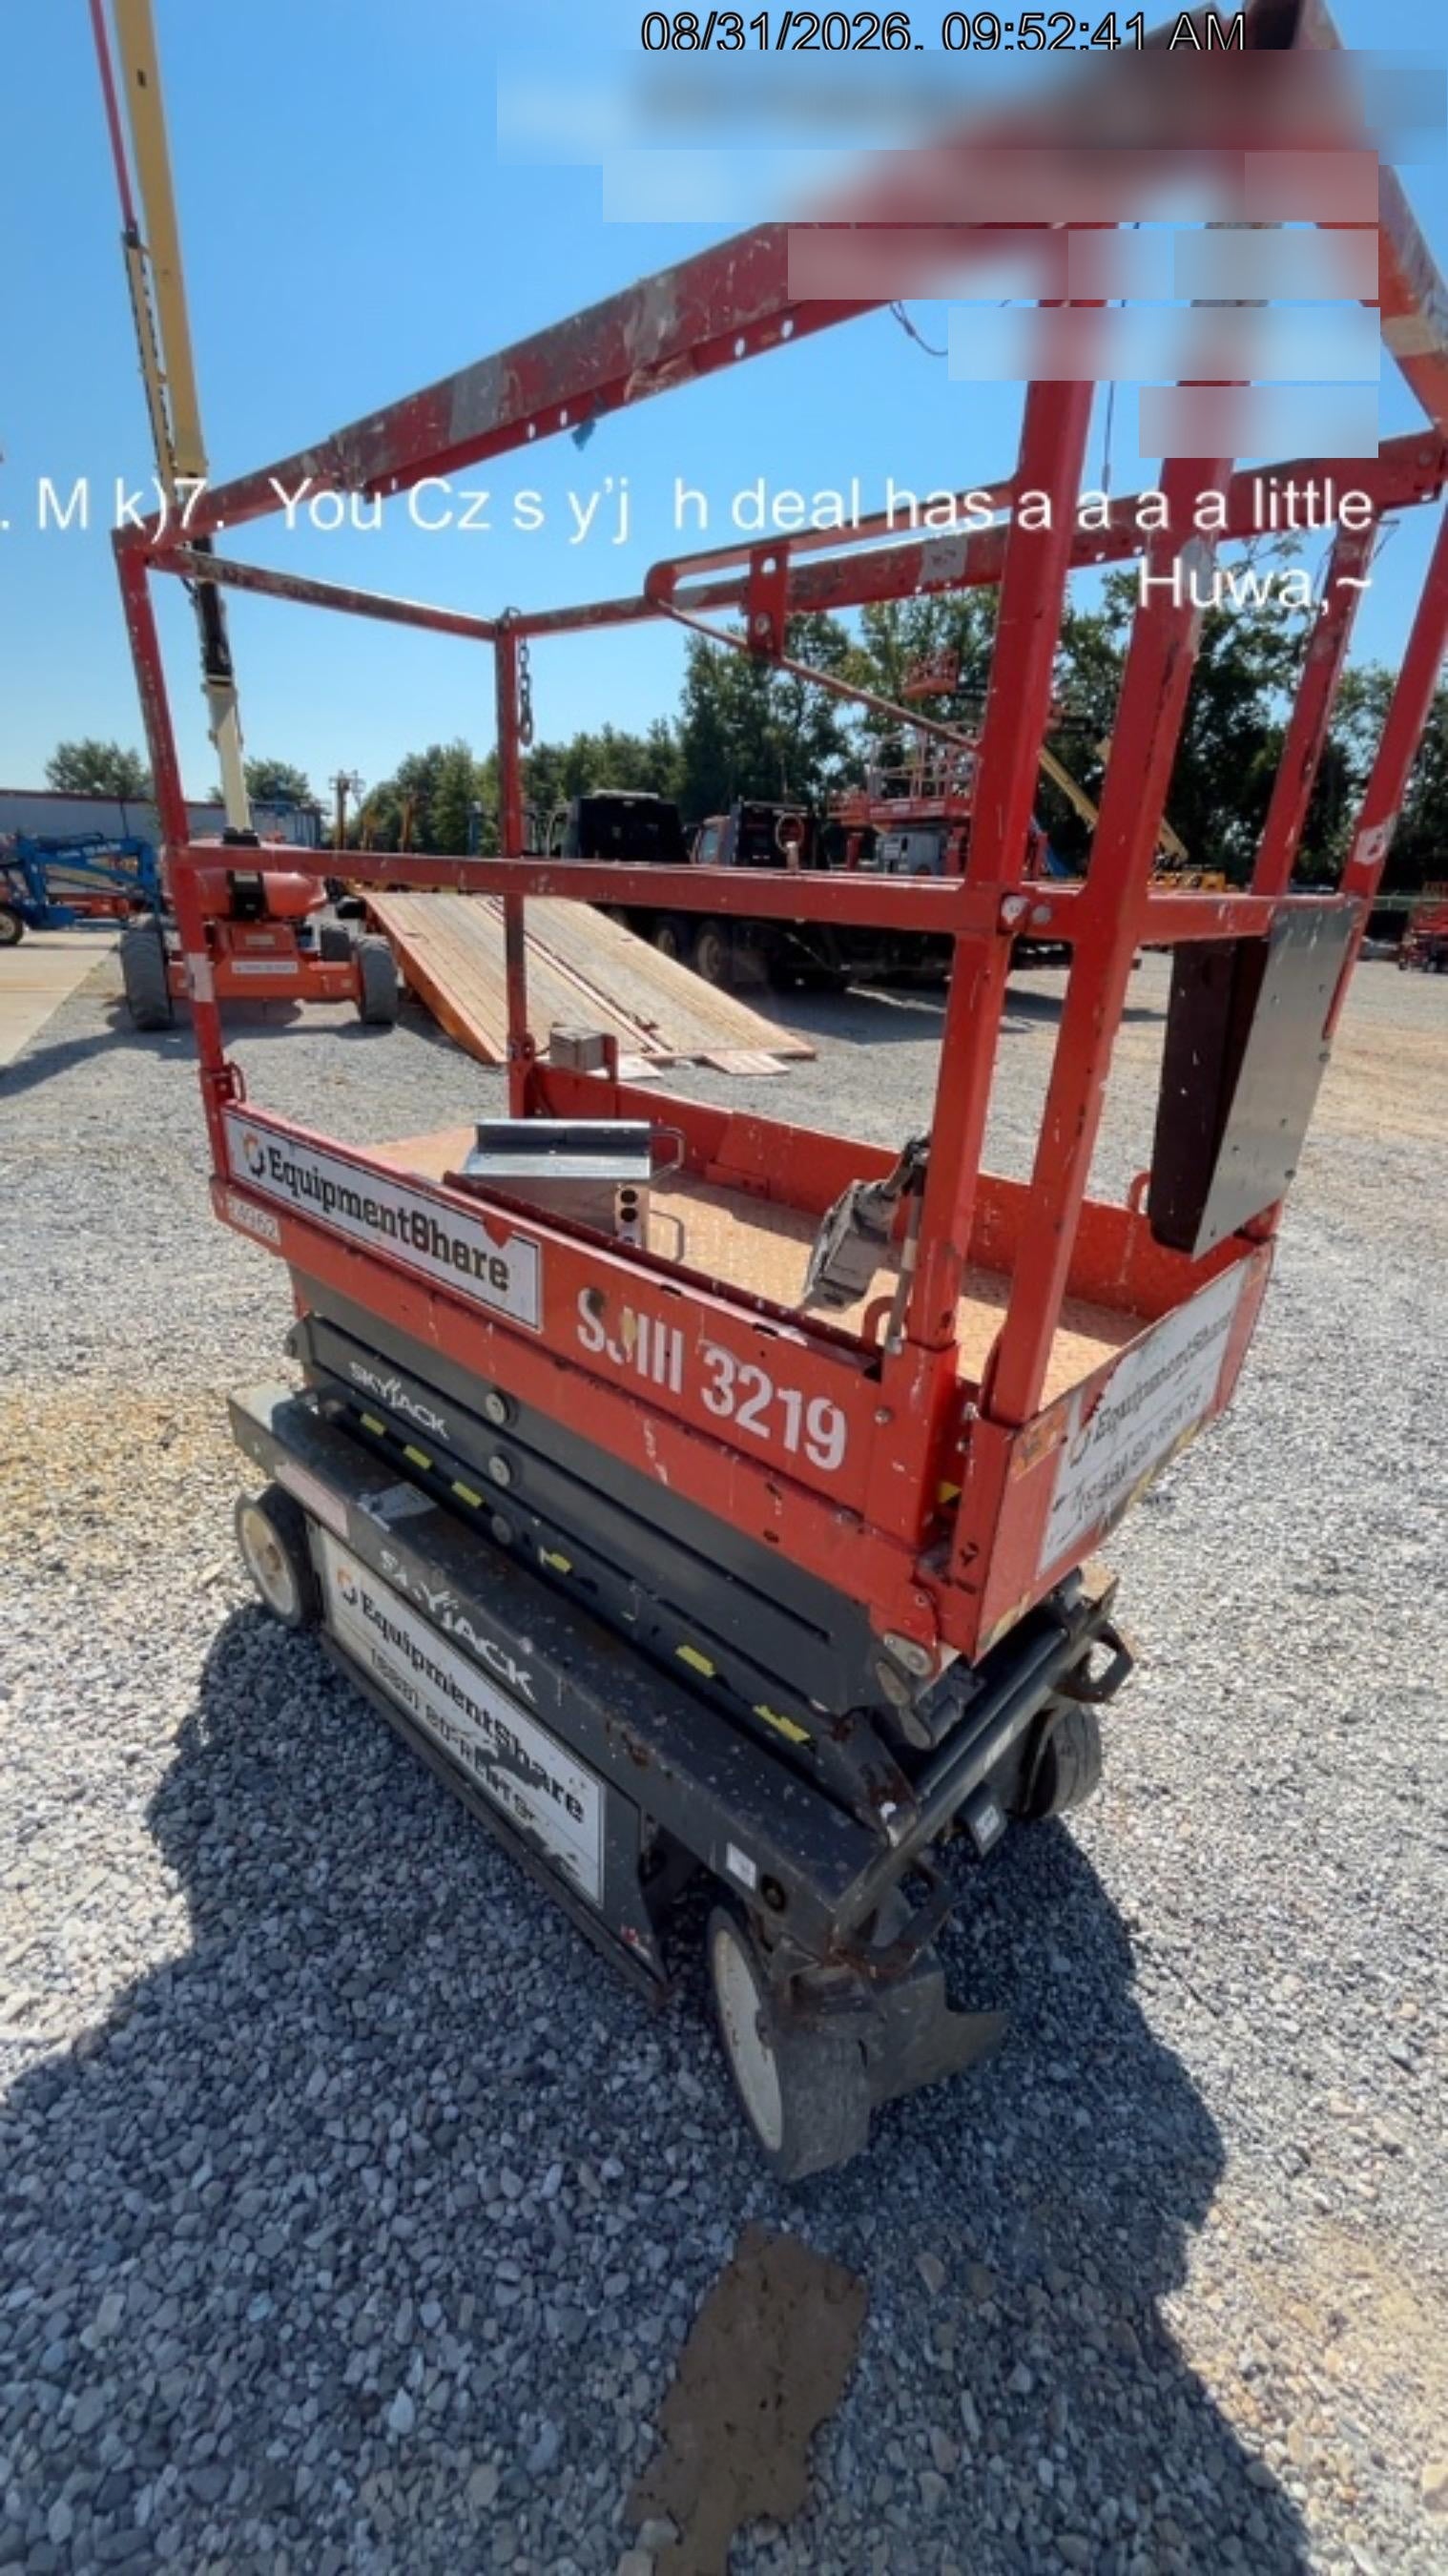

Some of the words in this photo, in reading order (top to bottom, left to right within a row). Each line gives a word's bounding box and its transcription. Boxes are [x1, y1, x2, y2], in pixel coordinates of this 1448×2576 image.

[267, 1145, 509, 1292] EquipmentShare
[348, 1360, 451, 1441] SKYJACK
[700, 1346, 847, 1470] 3219
[359, 1588, 586, 1824] EquipmentShare
